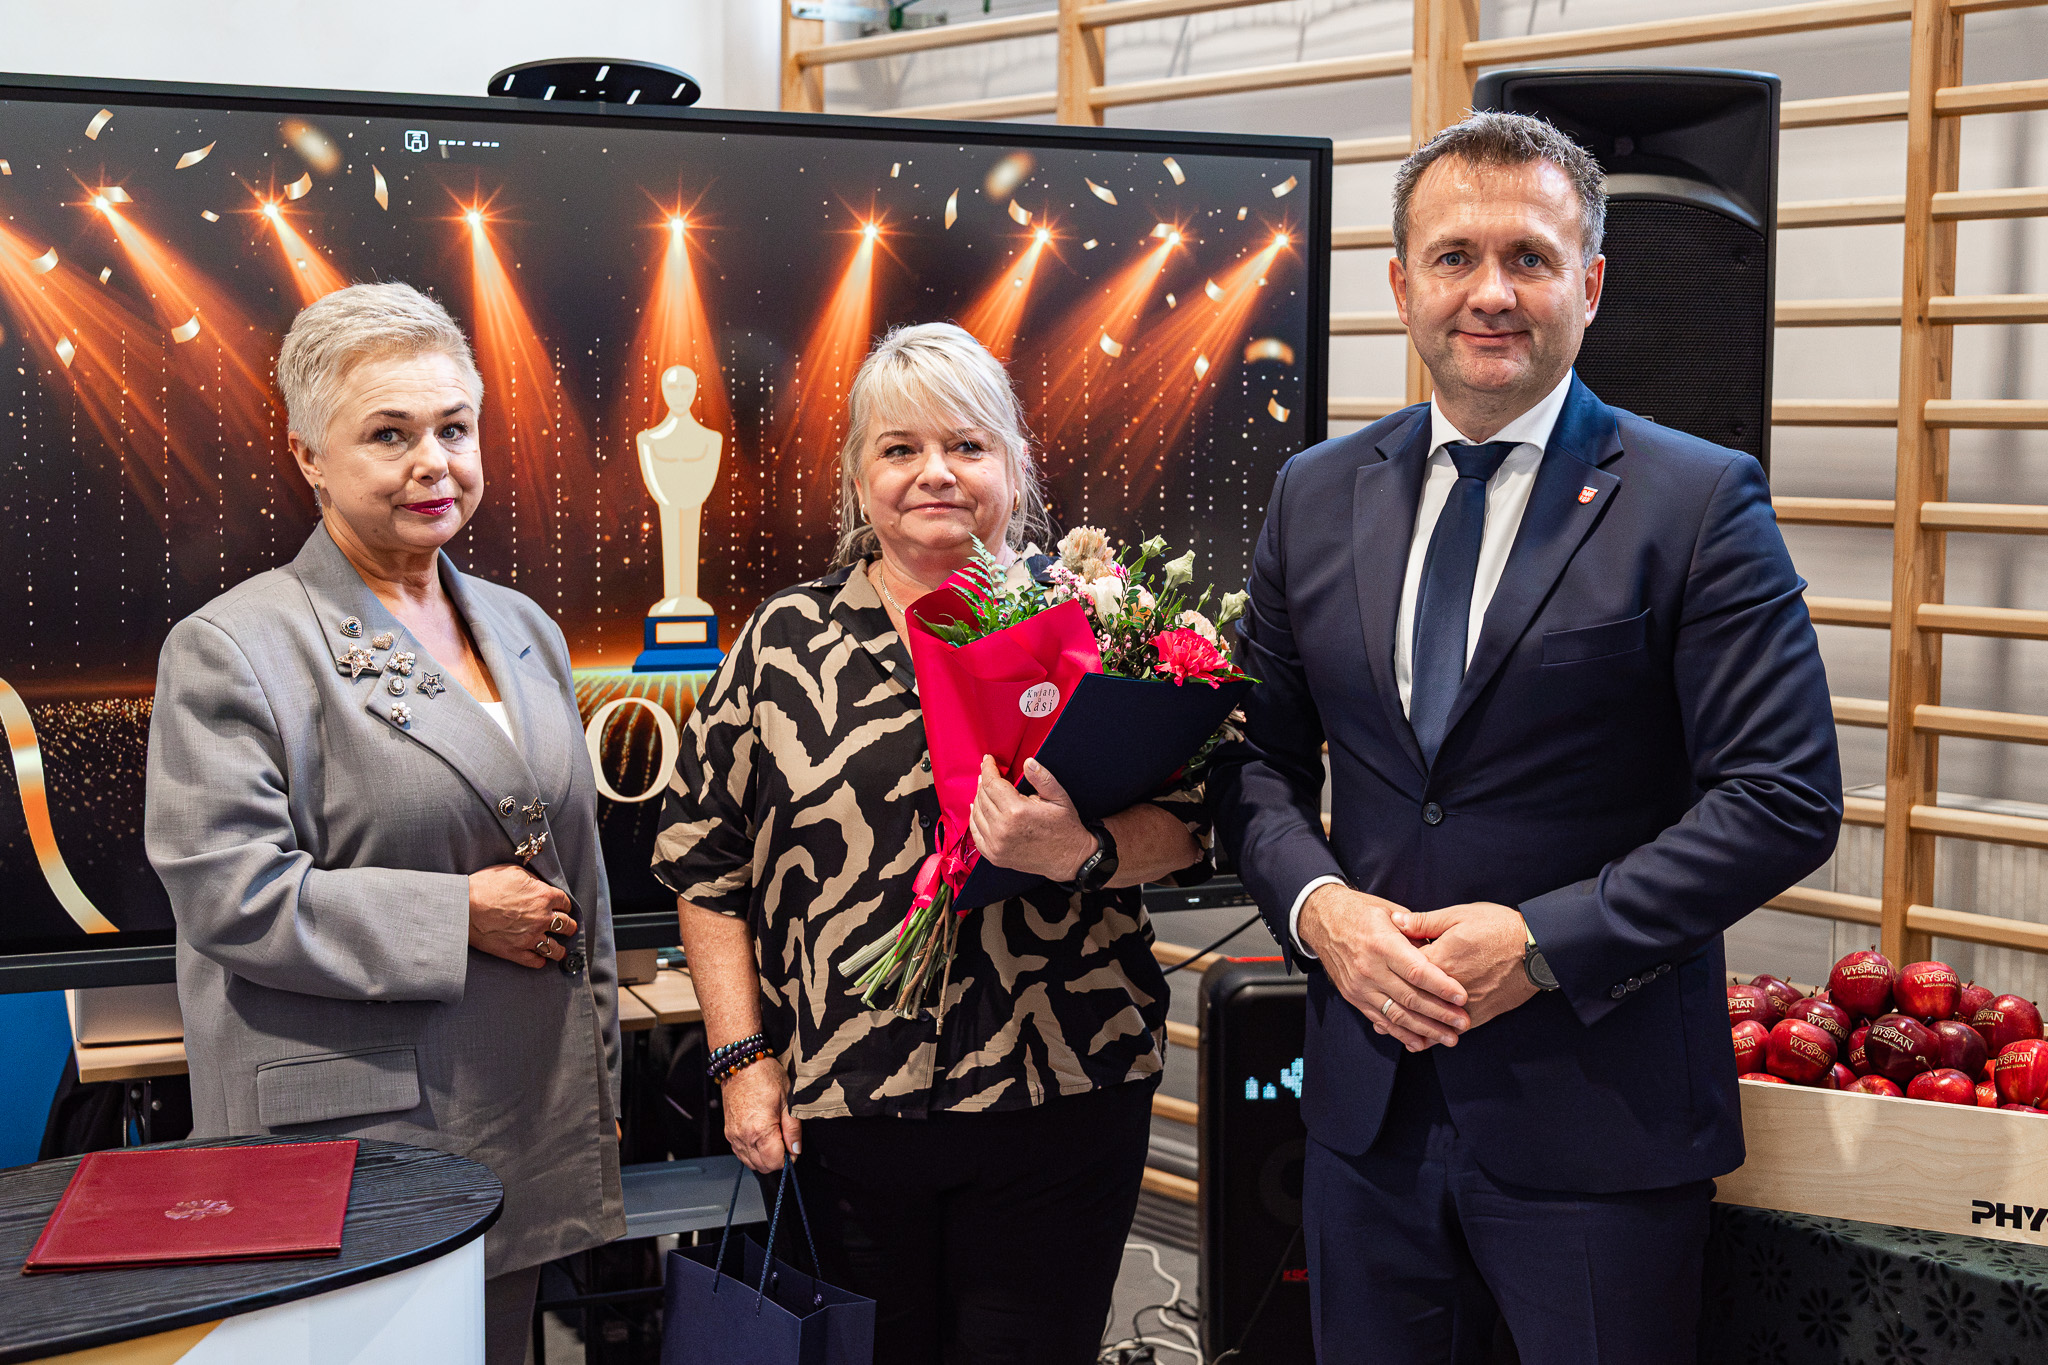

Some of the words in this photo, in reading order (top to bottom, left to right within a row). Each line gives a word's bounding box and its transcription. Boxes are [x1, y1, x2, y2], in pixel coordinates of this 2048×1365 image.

[1025, 700, 1053, 712] Kasi
[1027, 689, 1057, 698] Kwiaty
[1842, 964, 1888, 976] WYSPIAN
[1807, 1013, 1848, 1040] WYSPIAN
[1872, 1026, 1914, 1051] WYSPIAN
[1790, 1036, 1830, 1065] WYSPIAN
[1972, 1200, 2048, 1232] PHY
